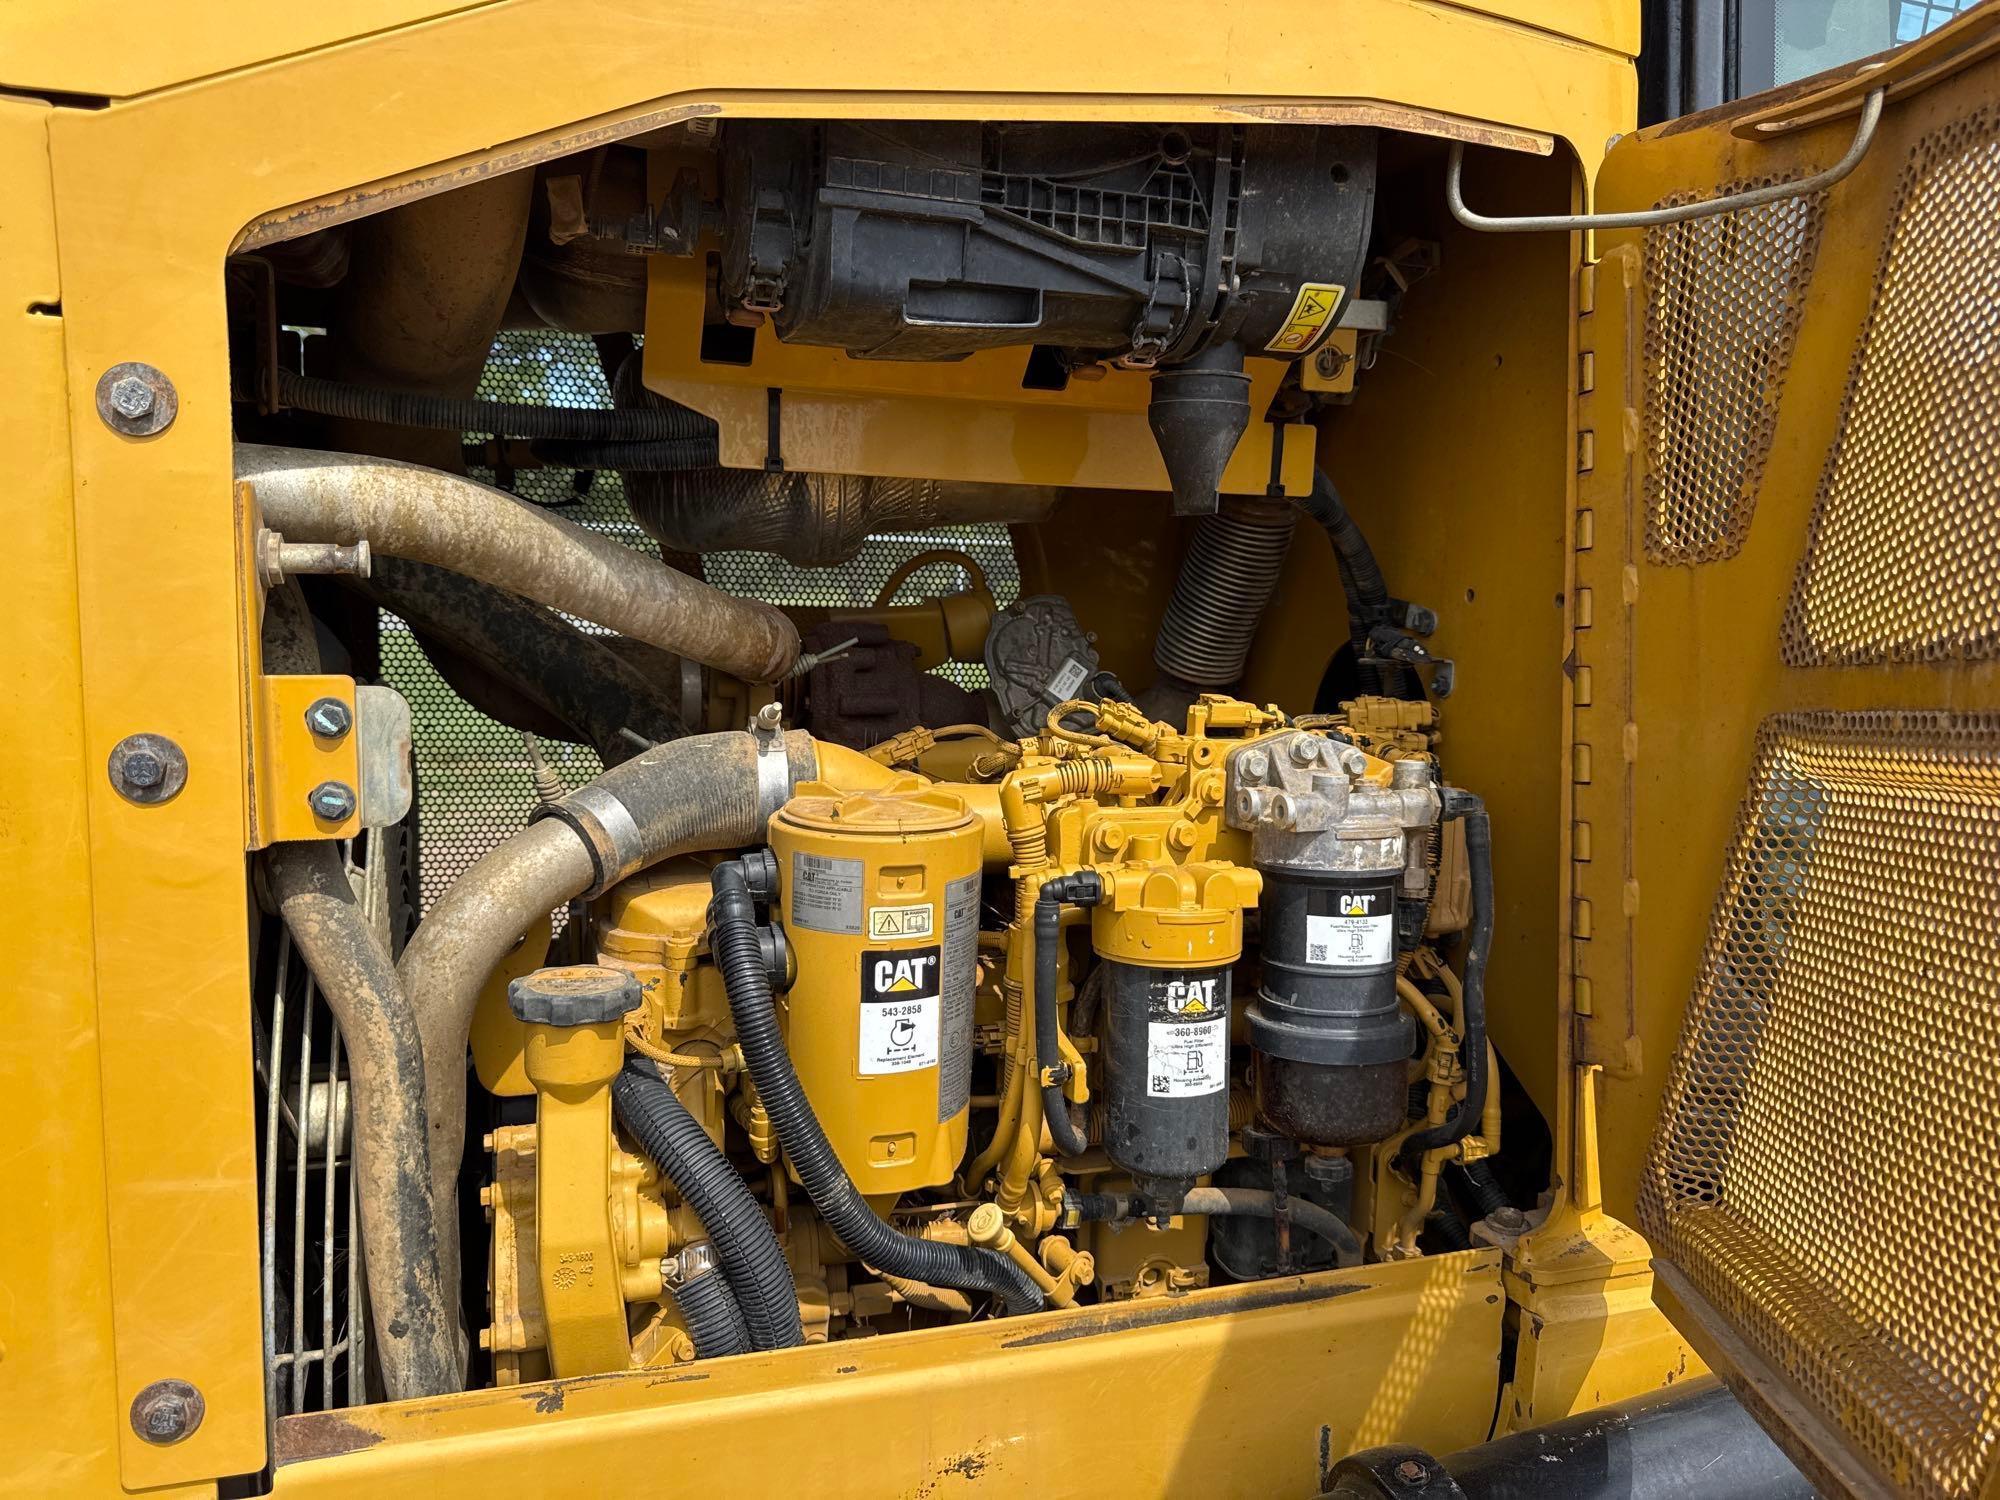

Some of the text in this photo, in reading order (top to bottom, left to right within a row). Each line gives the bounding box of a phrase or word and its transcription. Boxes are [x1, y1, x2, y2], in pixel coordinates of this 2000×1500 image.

[1167, 979, 1216, 1013] CAT
[882, 1004, 922, 1017] 543-2858
[1174, 1025, 1212, 1037] 360-8960
[877, 1055, 907, 1063] Replacement
